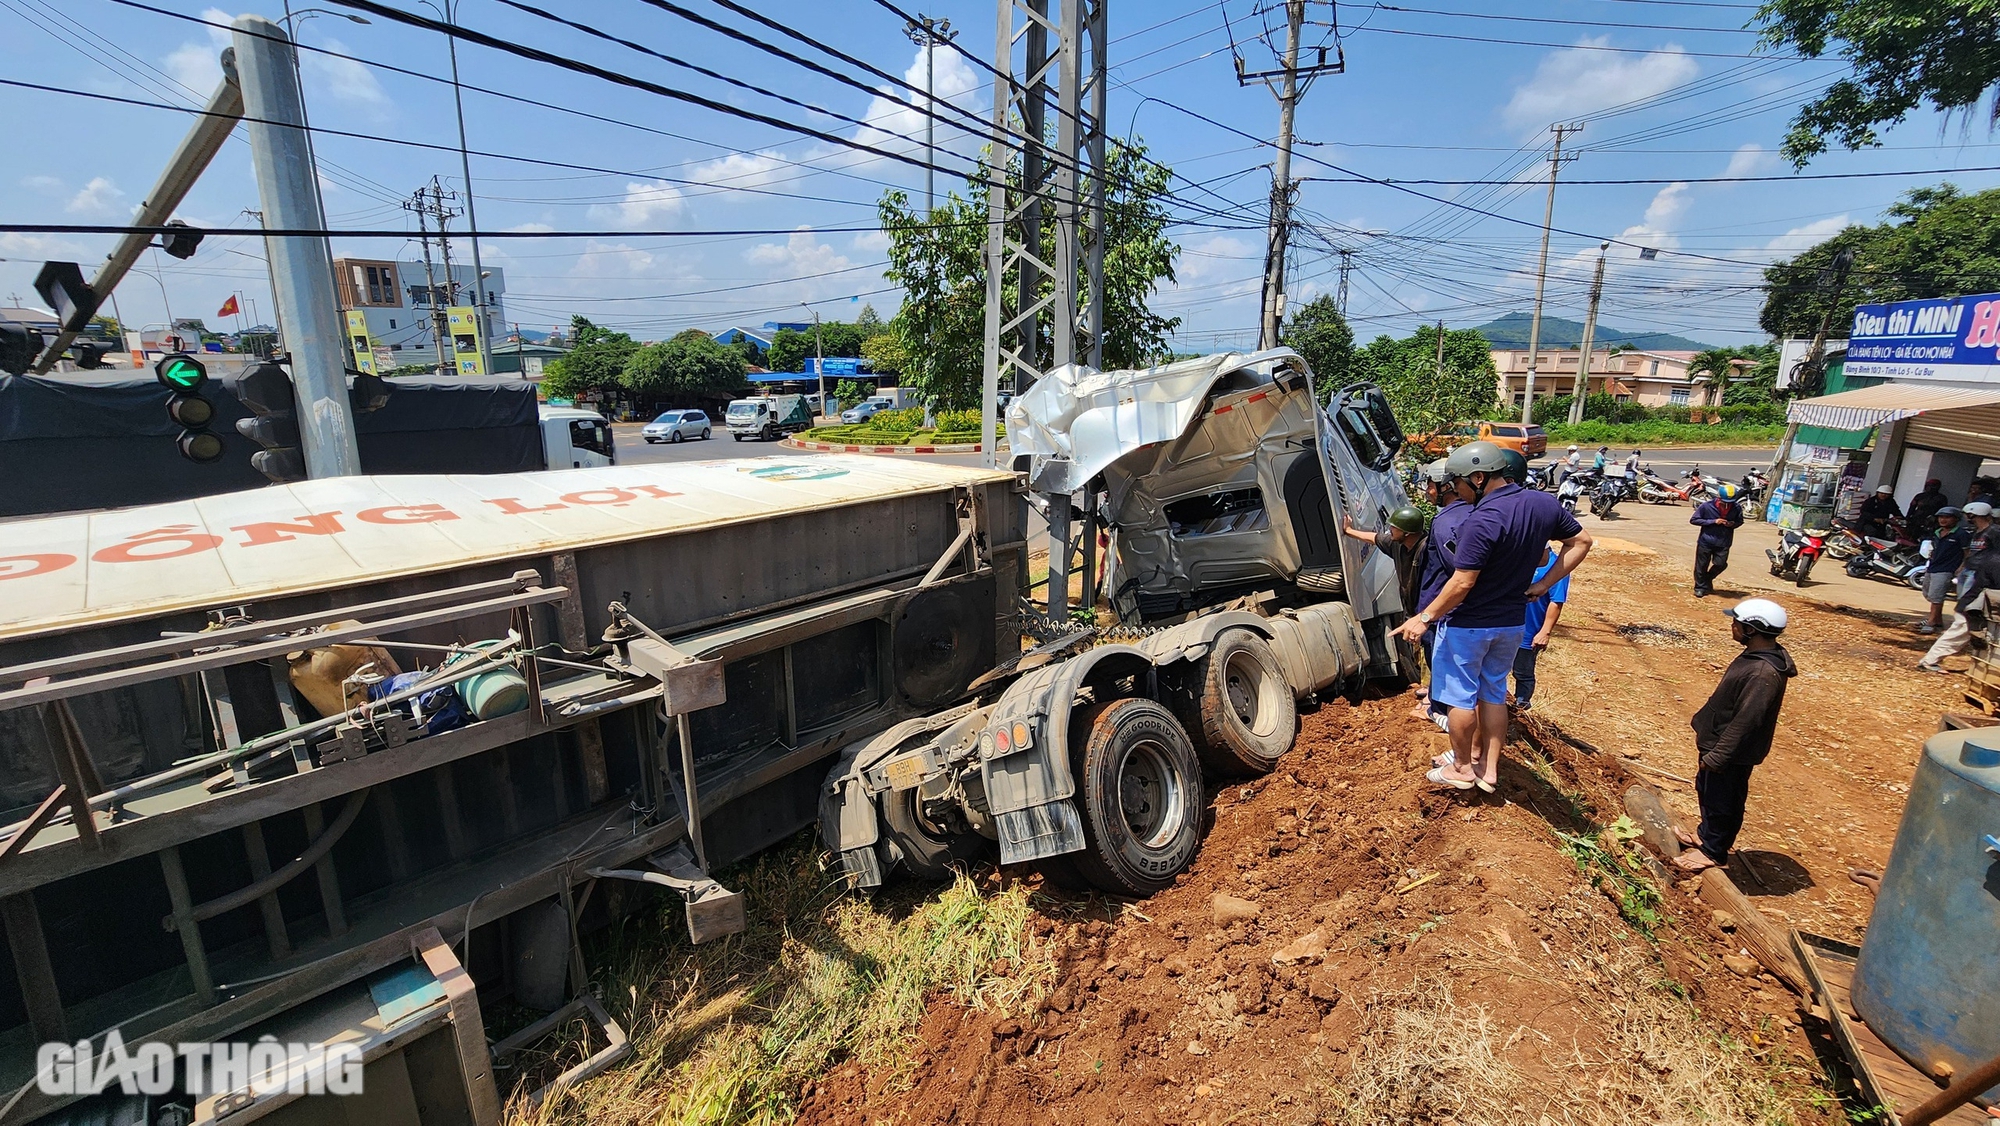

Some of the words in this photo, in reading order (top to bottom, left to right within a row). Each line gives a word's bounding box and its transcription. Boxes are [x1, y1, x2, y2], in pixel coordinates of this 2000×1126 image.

[1887, 309, 1914, 338] thị
[1912, 305, 1965, 334] MINI
[1912, 346, 1926, 359] CHO
[480, 484, 685, 515] LỢI
[1131, 720, 1177, 742] GOODRIDE
